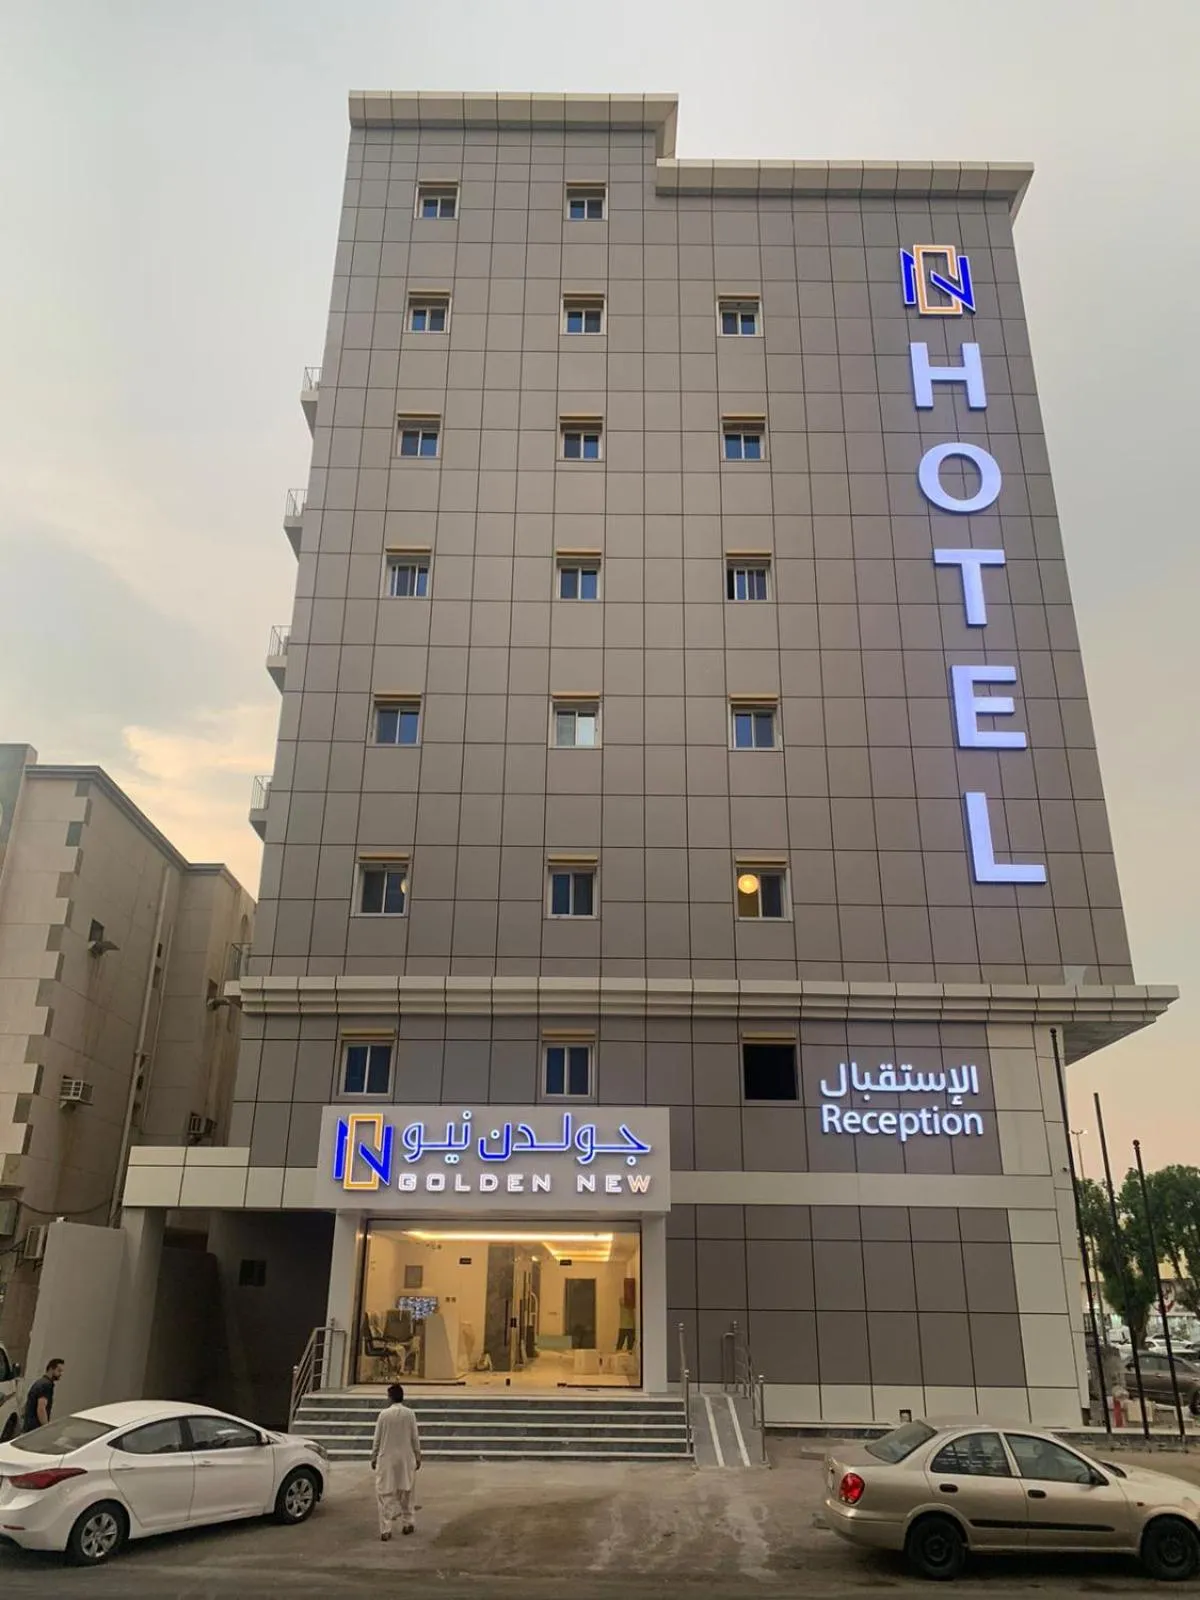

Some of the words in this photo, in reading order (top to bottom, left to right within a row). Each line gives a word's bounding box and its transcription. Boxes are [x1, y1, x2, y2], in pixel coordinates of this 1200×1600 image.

[910, 341, 1047, 883] HOTEL
[820, 1062, 979, 1105] الإستقبال
[402, 1110, 472, 1165] نيو
[478, 1112, 652, 1165] جولدن
[821, 1104, 984, 1142] Reception
[398, 1173, 551, 1193] GOLDEN
[576, 1174, 650, 1193] NEW
